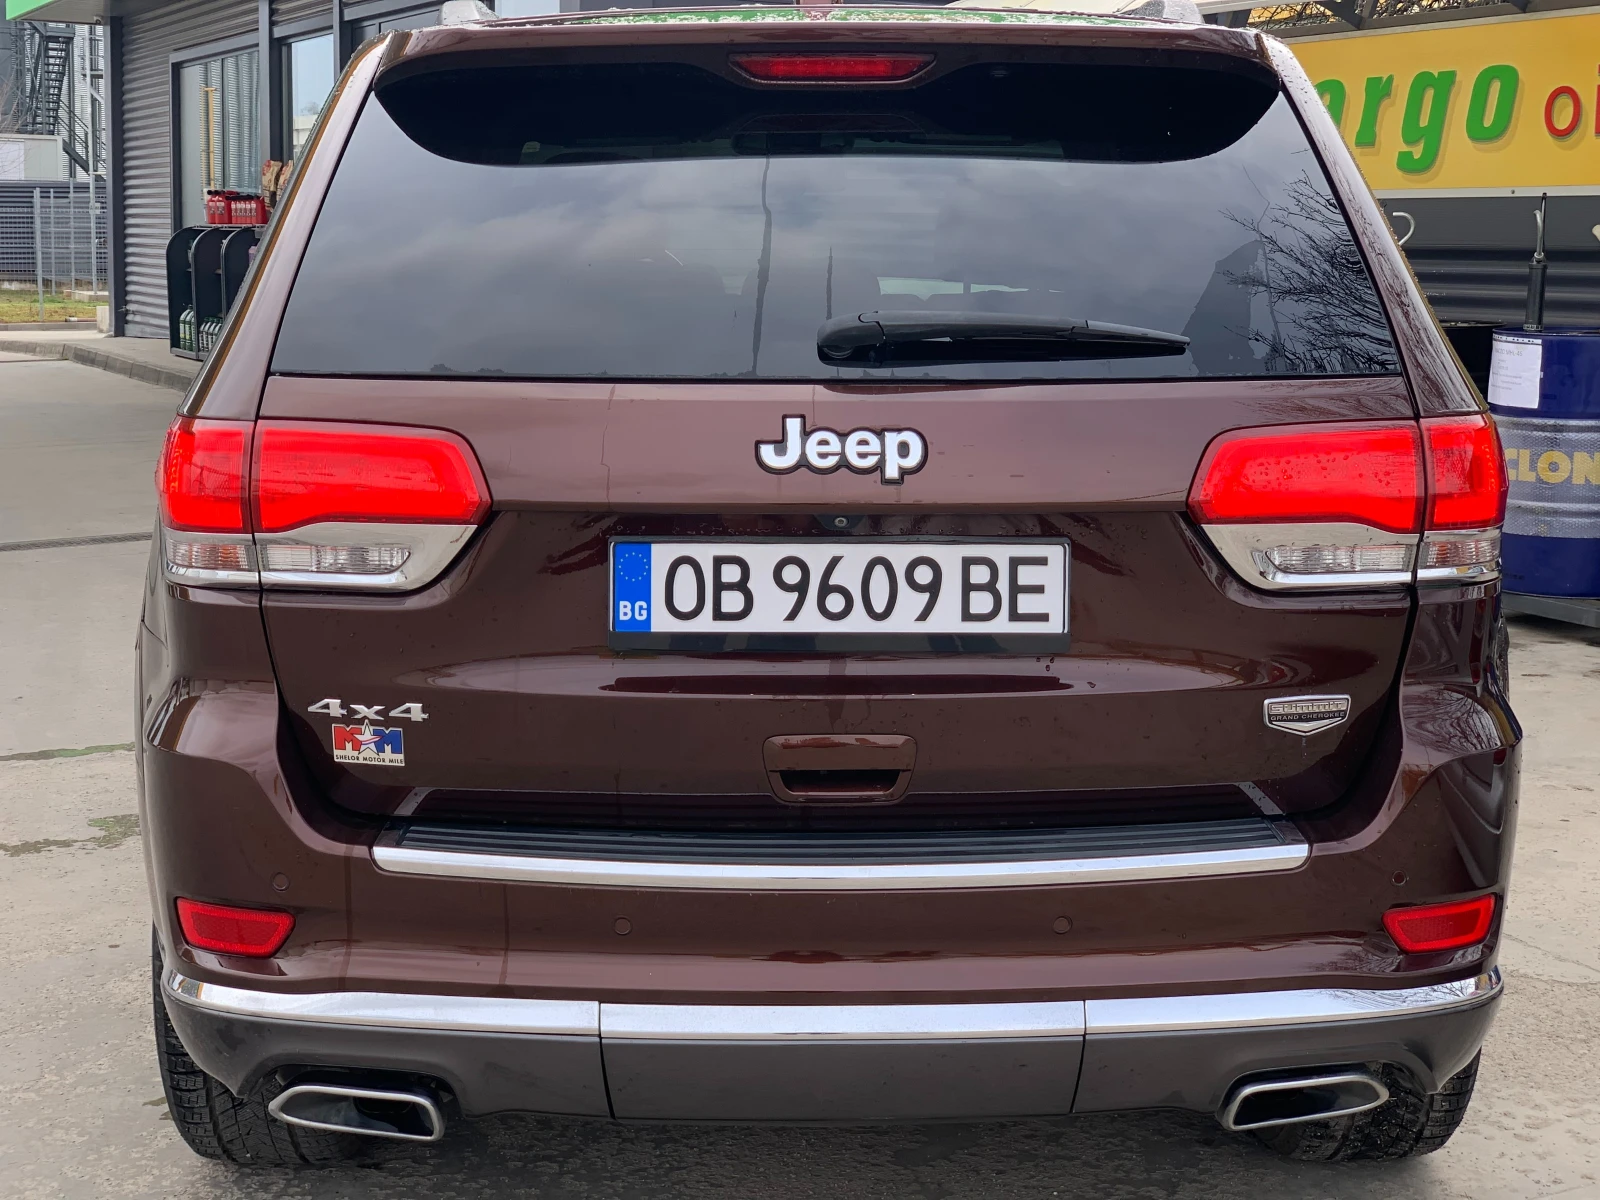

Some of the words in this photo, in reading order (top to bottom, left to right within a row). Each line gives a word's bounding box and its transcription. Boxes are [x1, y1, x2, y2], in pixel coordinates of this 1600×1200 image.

[757, 415, 926, 483] Jeep
[664, 555, 754, 622] OB
[772, 555, 943, 622] 9609
[960, 555, 1050, 622] BE
[619, 600, 648, 620] BG
[307, 698, 429, 721] 4x4
[1301, 711, 1345, 719] CHEROKEE
